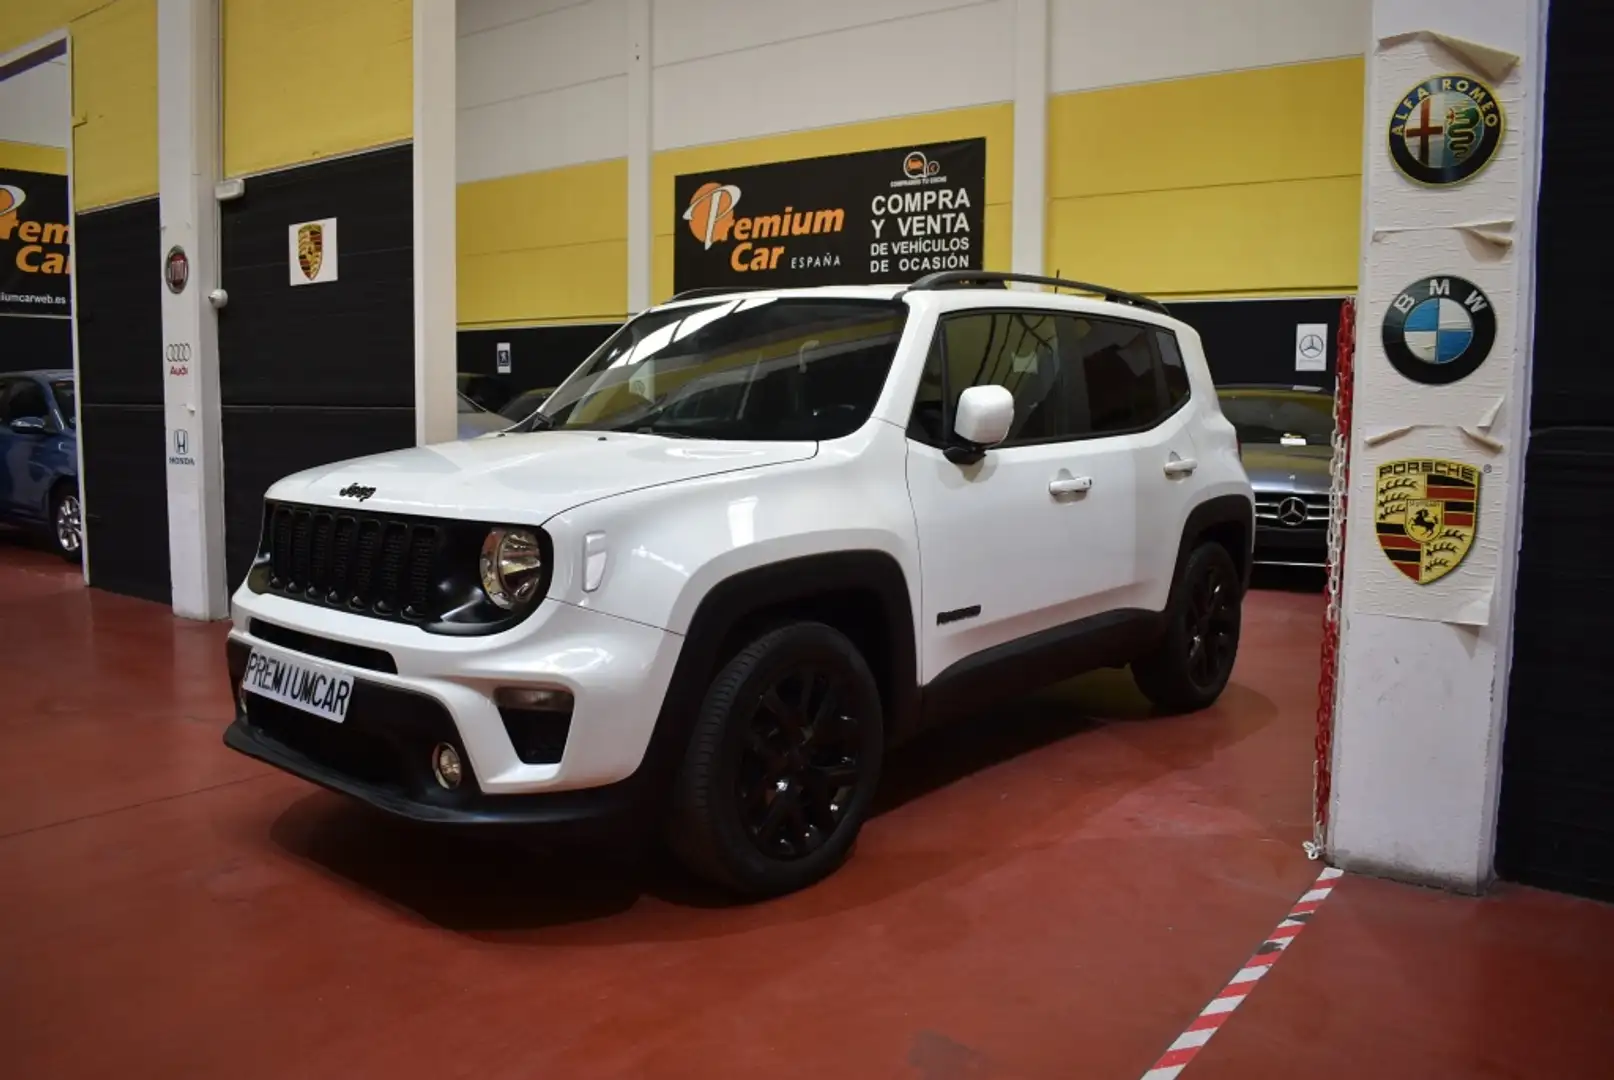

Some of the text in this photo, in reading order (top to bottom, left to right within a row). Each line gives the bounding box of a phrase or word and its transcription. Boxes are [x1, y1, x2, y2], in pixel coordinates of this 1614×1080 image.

[1391, 78, 1498, 136] ALFA ROMEO
[871, 188, 971, 216] COMPRA
[682, 183, 845, 250] Premium
[871, 212, 970, 239] Y VENTA
[16, 244, 71, 275] Ca
[731, 243, 842, 272] Car ESPAÑA
[870, 237, 970, 257] DE VEHÍCULOS
[870, 254, 970, 273] DE OCASIÓN
[1393, 278, 1488, 314] BMW
[169, 365, 189, 376] Audi
[168, 456, 195, 466] HONDA
[1379, 461, 1475, 482] PORSCHE
[244, 652, 351, 717] PREMIUMCAR
